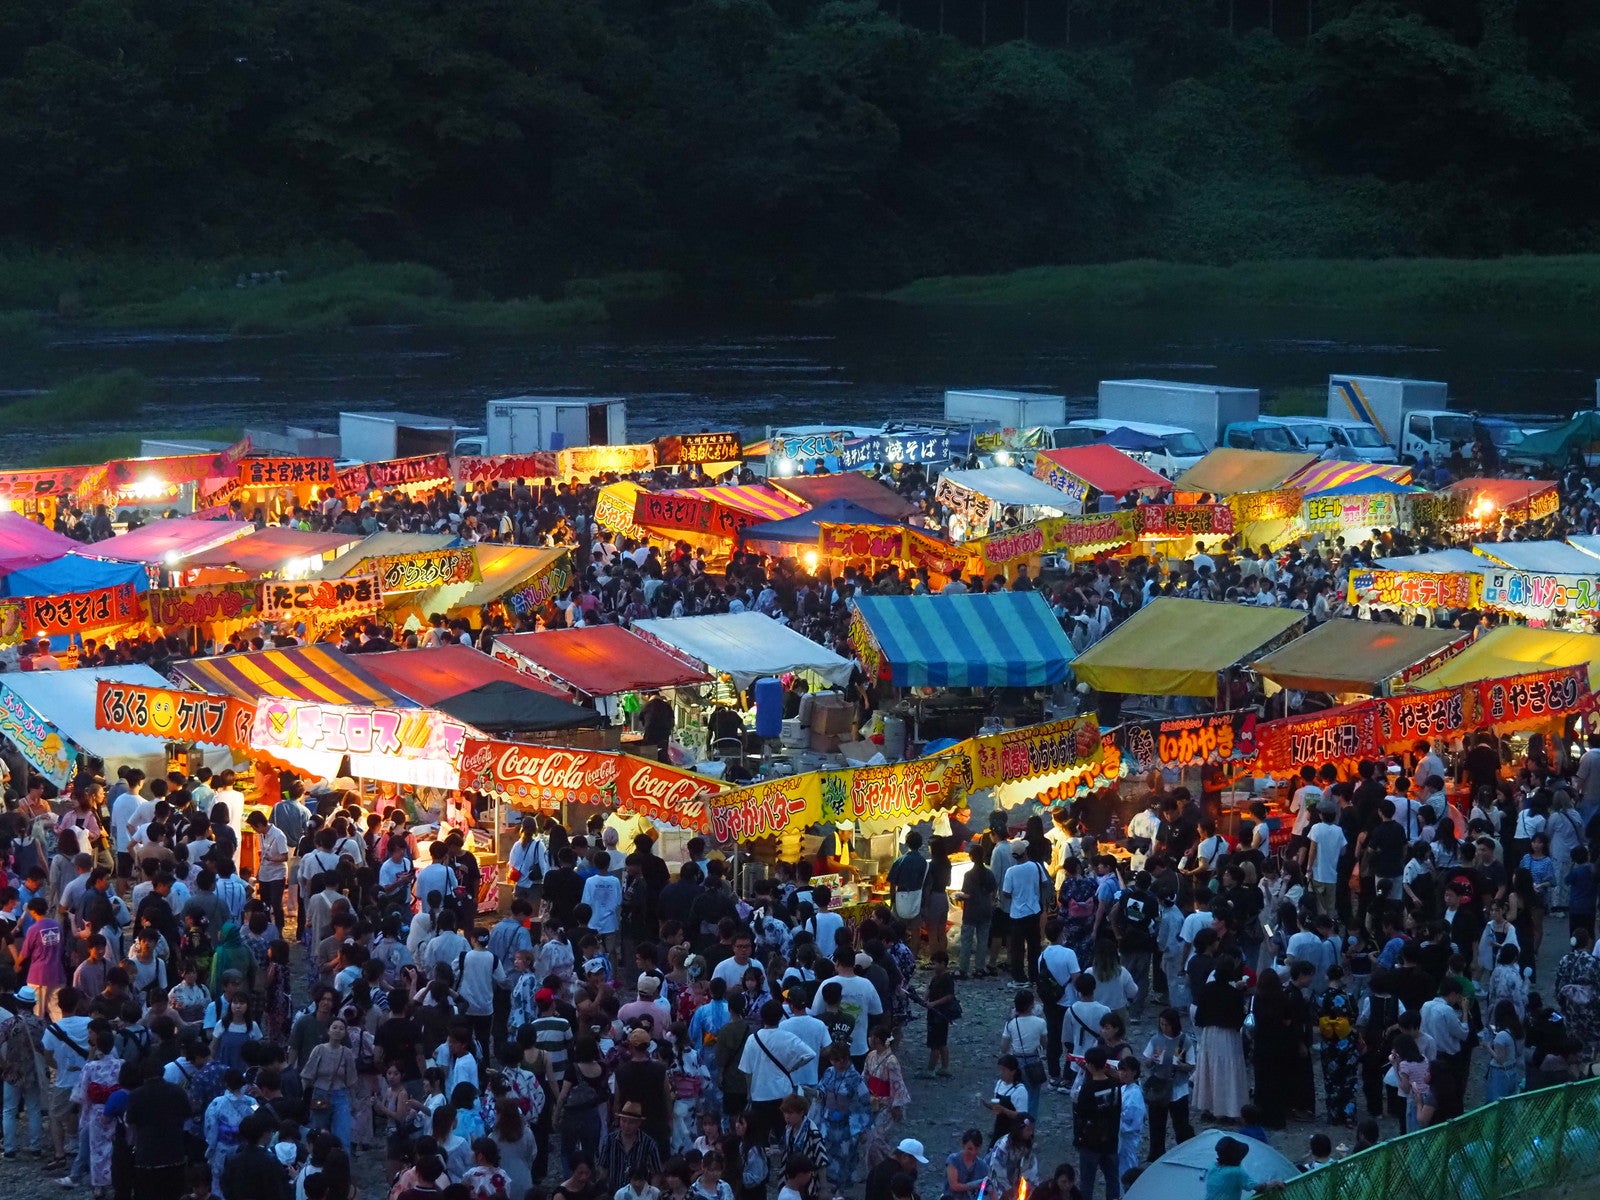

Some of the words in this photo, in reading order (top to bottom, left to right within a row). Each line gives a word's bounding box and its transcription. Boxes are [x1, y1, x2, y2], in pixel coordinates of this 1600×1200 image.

[884, 438, 937, 461] 焼そば
[250, 462, 330, 483] 富士宮焼そば
[1049, 470, 1084, 502] やきそば
[650, 500, 697, 524] やきとり
[939, 483, 989, 518] たこやき
[1309, 498, 1342, 520] 生ビール
[1164, 510, 1212, 533] やきそば
[385, 559, 459, 590] からあげ
[1401, 578, 1450, 606] ポテト
[1508, 573, 1589, 609] ボトルジュース
[34, 592, 113, 628] やきそば
[273, 582, 372, 609] たこやき
[102, 688, 148, 727] くるくる
[1509, 676, 1578, 715] やきとり
[4, 692, 47, 741] ふわふわ
[175, 697, 227, 738] ケバブ
[296, 705, 402, 757] チュロス
[1399, 694, 1463, 738] やきそば
[1158, 723, 1235, 764] いかやき
[497, 746, 589, 790] Coca-Cola
[629, 765, 711, 819] Coca-Cola
[850, 772, 941, 817] じゃがバター
[711, 793, 806, 844] じゃがバター
